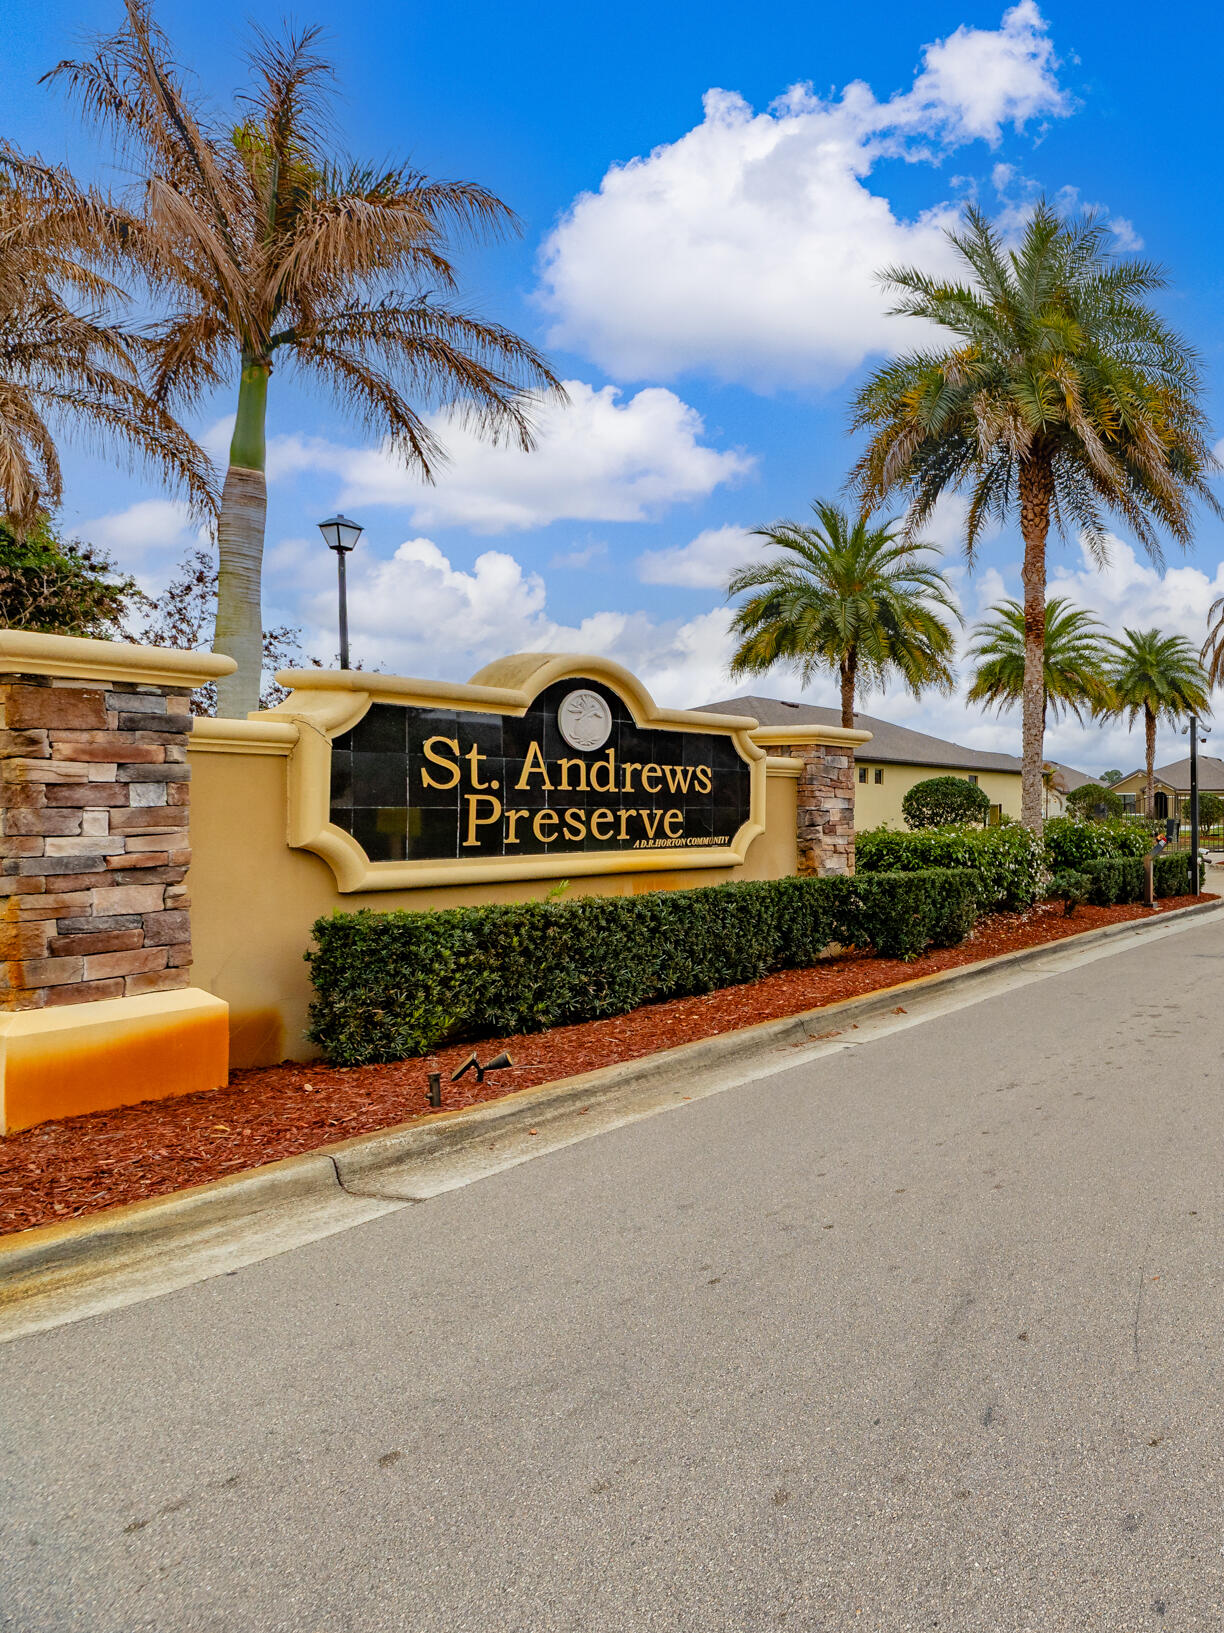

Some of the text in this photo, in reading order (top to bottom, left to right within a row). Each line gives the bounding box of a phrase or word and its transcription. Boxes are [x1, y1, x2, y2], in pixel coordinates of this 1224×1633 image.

[421, 735, 712, 794] St. Andrews
[462, 794, 684, 847] Preserve
[633, 840, 640, 848] A
[686, 836, 730, 846] COMMUNITY
